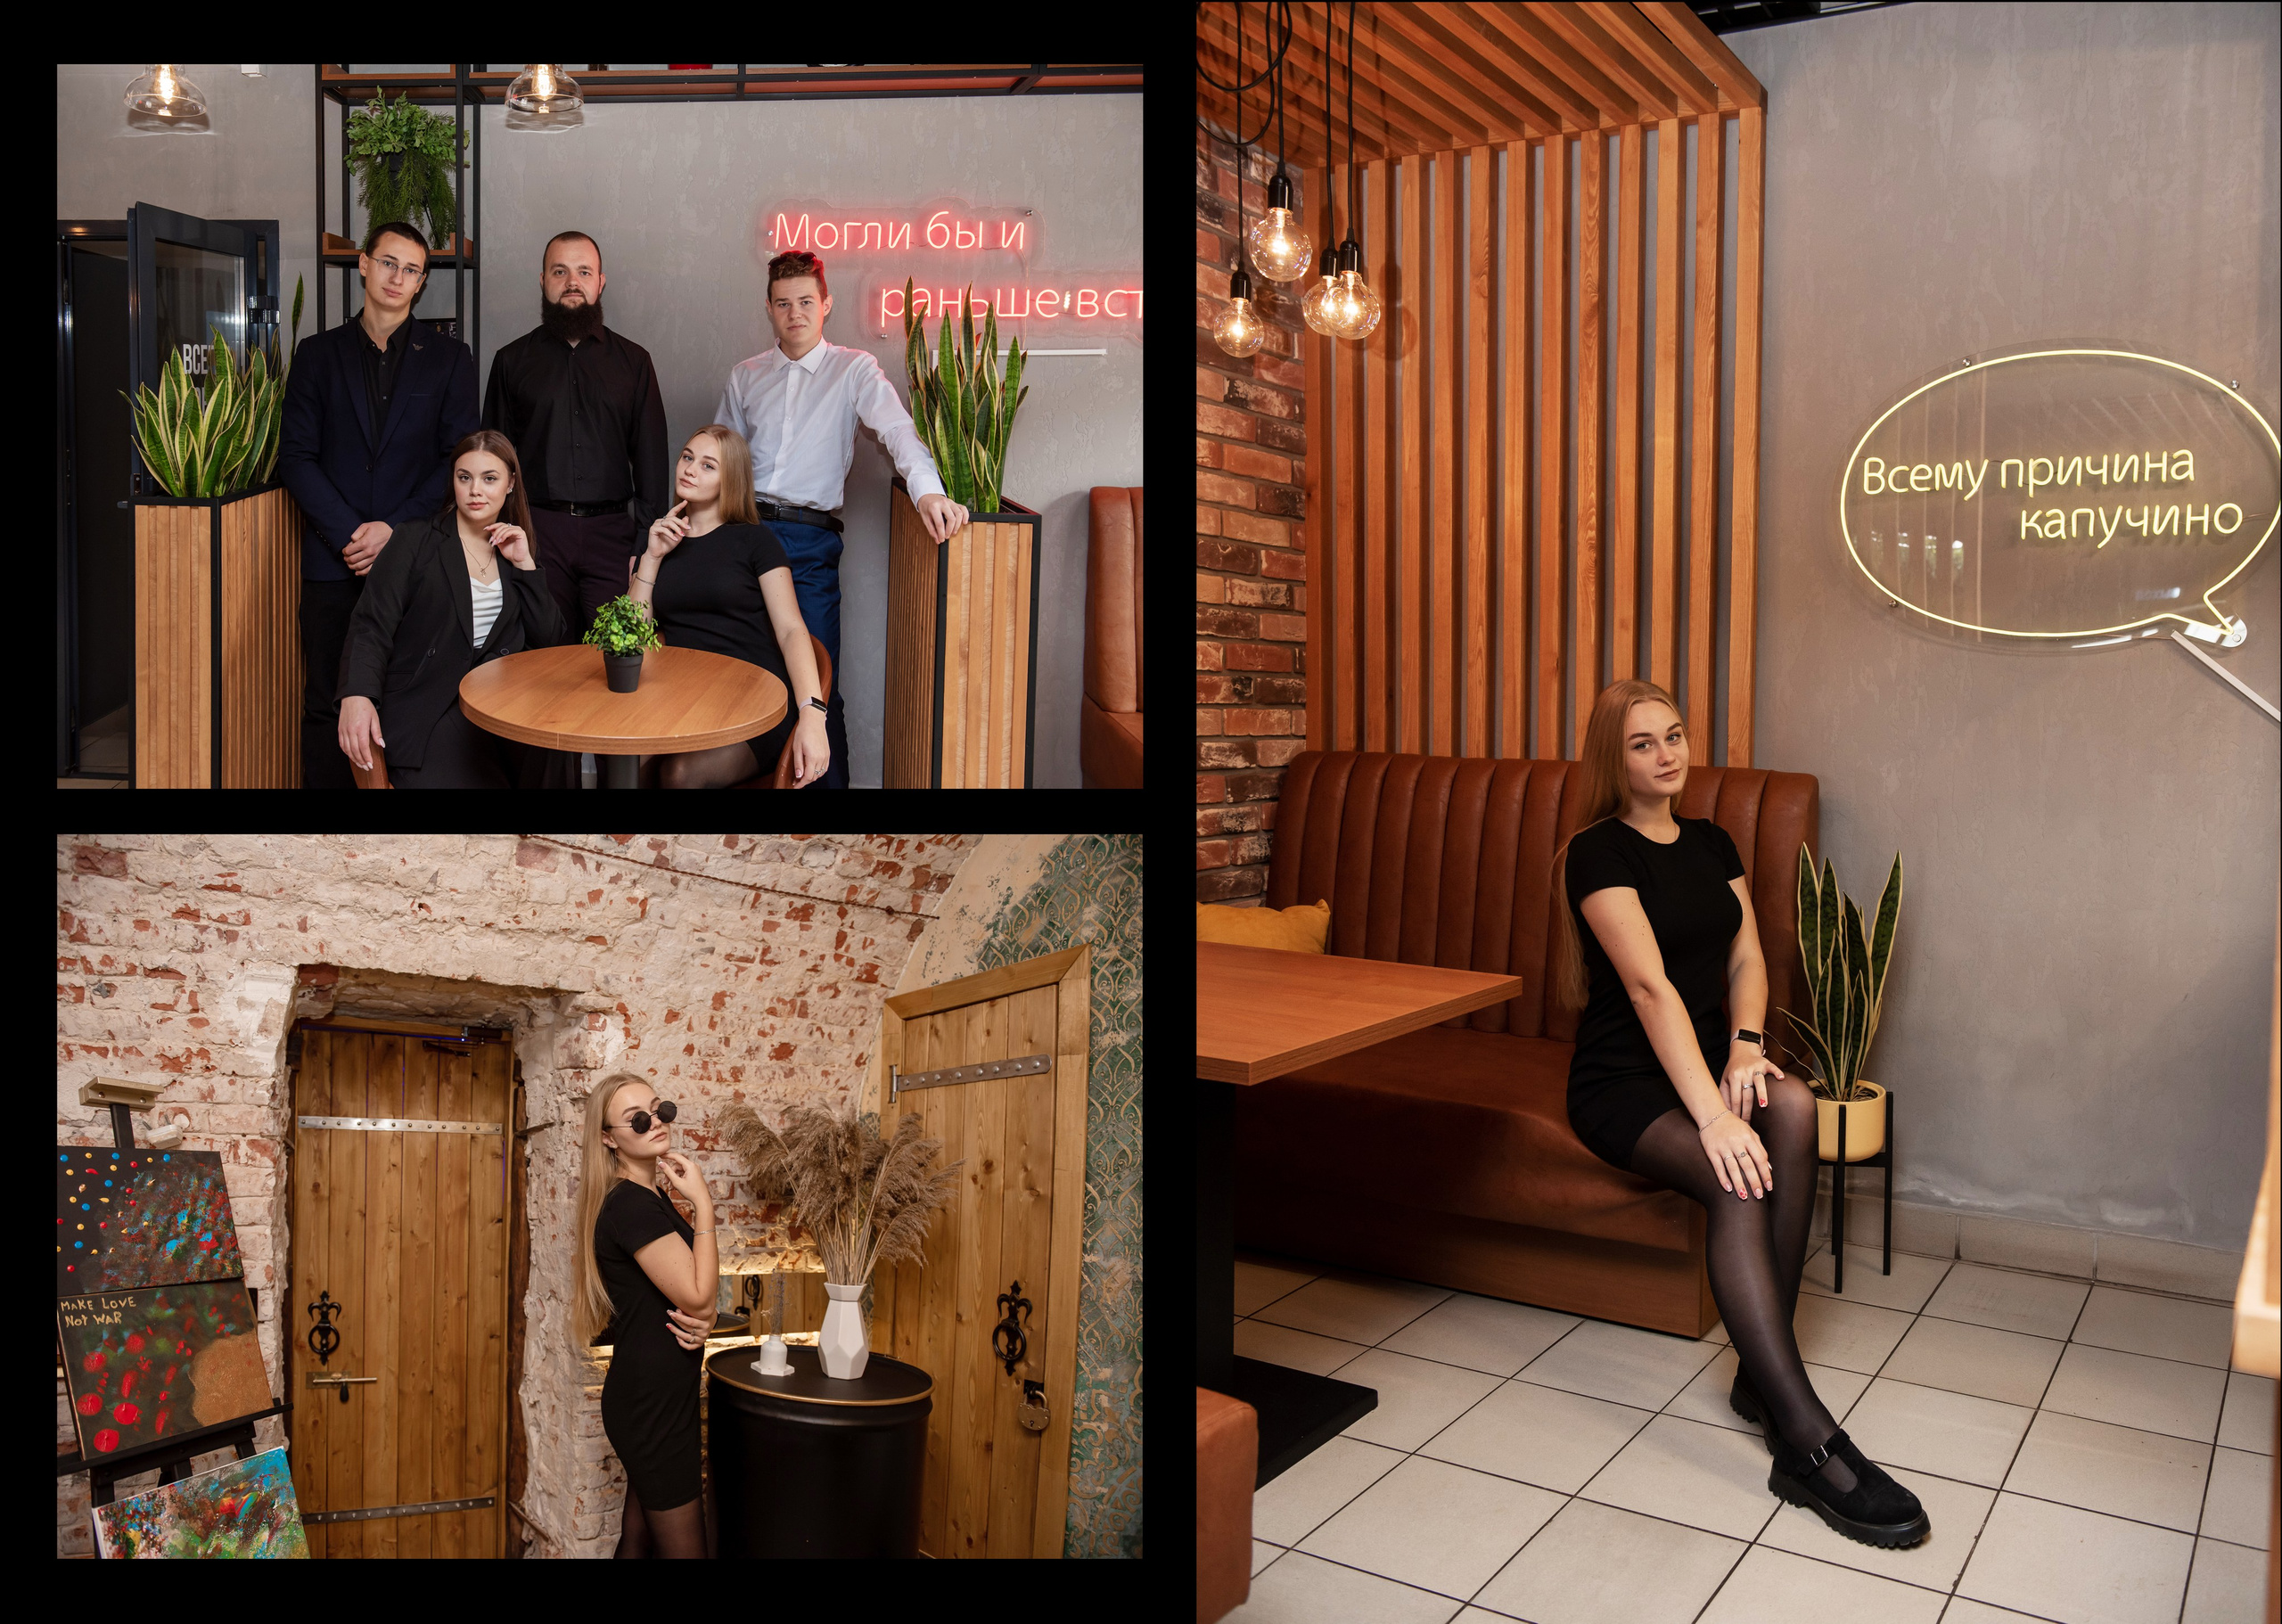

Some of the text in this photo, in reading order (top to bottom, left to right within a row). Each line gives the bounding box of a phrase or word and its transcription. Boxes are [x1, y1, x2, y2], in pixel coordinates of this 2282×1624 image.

[774, 210, 1026, 250] Могли бы и
[881, 288, 1060, 328] раньше
[183, 343, 215, 375] ВСЕ
[1862, 448, 2196, 501] Всему причина
[2020, 502, 2244, 549] капучино
[61, 1296, 136, 1311] MAKE LOVE
[93, 1311, 121, 1325] WAR
